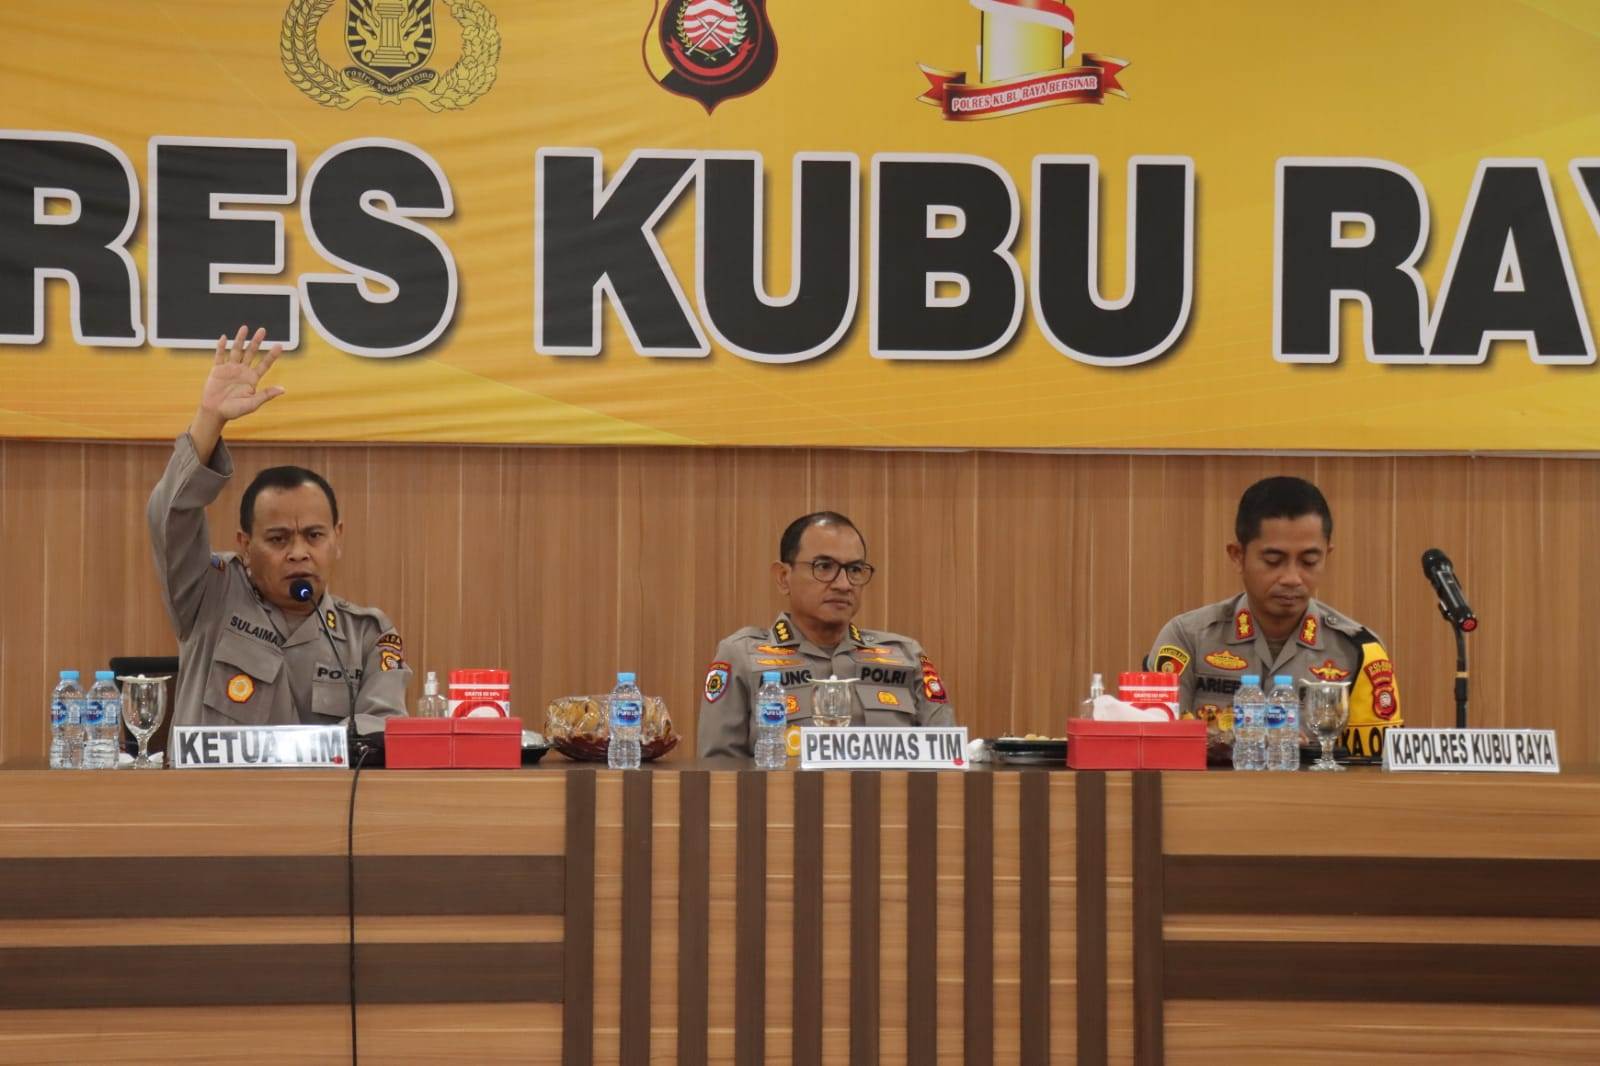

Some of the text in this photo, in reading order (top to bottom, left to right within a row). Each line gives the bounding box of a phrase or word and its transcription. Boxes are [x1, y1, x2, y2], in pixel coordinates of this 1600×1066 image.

[952, 96, 991, 111] POLRES
[1021, 83, 1047, 99] RAYA
[1048, 76, 1098, 93] BERSINAR
[534, 147, 1195, 367] KUBU
[861, 667, 906, 684] POLRI
[179, 731, 282, 763] KETUA
[806, 733, 963, 760] PENGAWAS TIM
[1392, 733, 1469, 764] KAPOLRES
[1471, 733, 1512, 764] KUBU
[1515, 734, 1554, 765] RAYA
